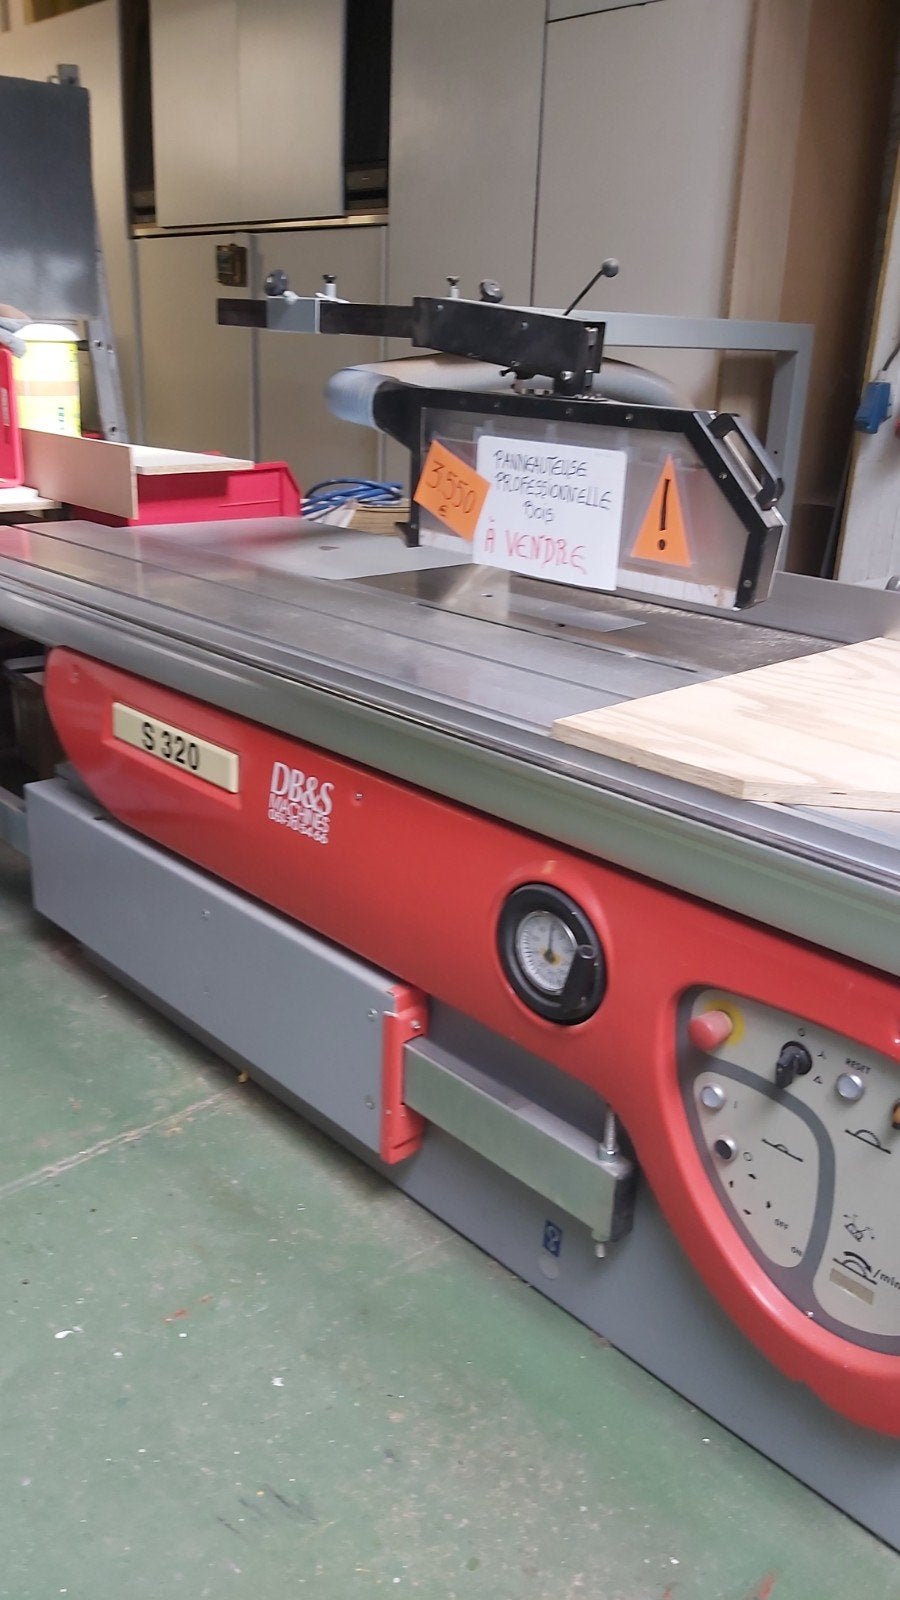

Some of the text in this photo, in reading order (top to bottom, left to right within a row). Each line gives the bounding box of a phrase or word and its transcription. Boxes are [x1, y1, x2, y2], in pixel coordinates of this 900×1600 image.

[493, 449, 588, 478] PANNEAUTEUSE
[494, 471, 612, 510] PROFESSIONNELLE
[505, 530, 587, 575] VENDRE
[142, 722, 200, 771] S 320
[270, 761, 335, 816] DB&S
[268, 793, 330, 833] MACHINES
[845, 1057, 872, 1074] RESET
